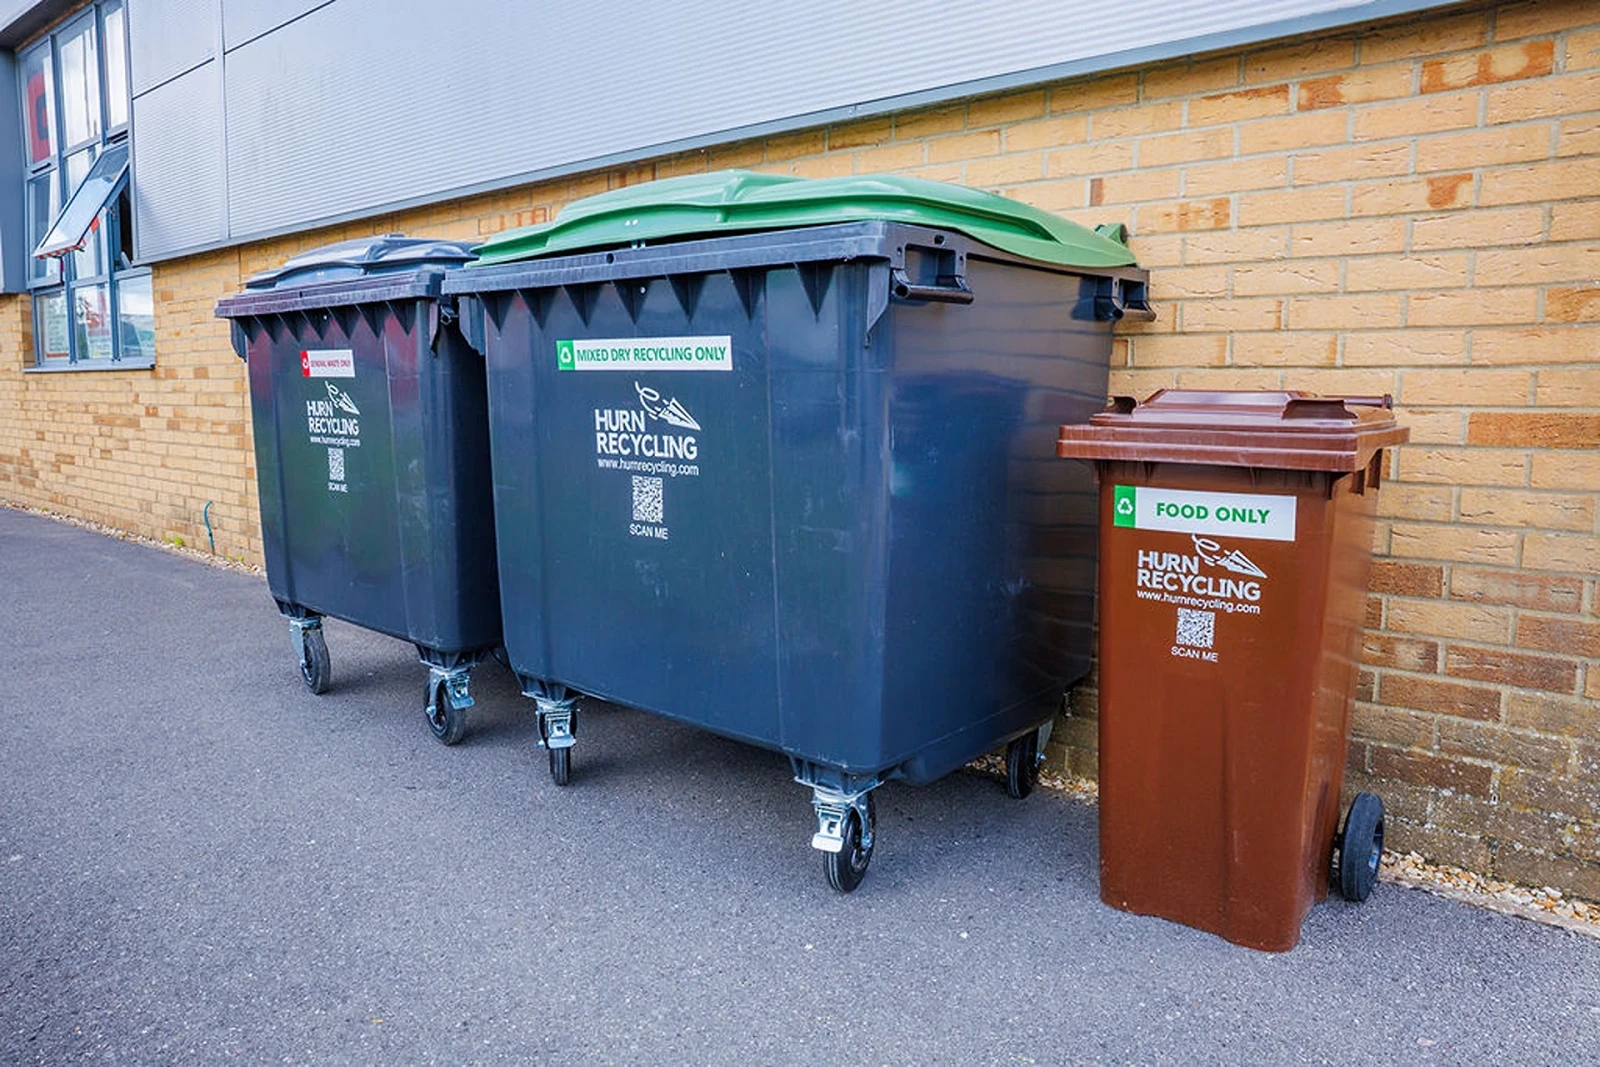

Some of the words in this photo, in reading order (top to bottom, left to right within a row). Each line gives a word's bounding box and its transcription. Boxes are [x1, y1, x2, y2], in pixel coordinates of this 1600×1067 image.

[577, 348, 610, 362] MIXED
[611, 348, 631, 361] DRY
[634, 346, 693, 361] RECYCLING
[695, 346, 726, 361] ONLY
[306, 400, 334, 417] HURN
[308, 417, 359, 435] RECYCLING
[595, 409, 645, 432] HURN
[596, 433, 698, 460] RECYCLING
[598, 458, 700, 477] www.hurnrecycling.com
[1156, 502, 1209, 520] FOOD
[1215, 506, 1271, 524] ONLY
[629, 523, 653, 538] SCAN
[654, 526, 668, 540] ME
[1137, 550, 1200, 575] HURN
[1137, 569, 1261, 601] RECYCLING
[1136, 590, 1261, 614] www.hurnrecycling.com
[1171, 646, 1200, 660] SCAN
[1202, 651, 1218, 663] ME
